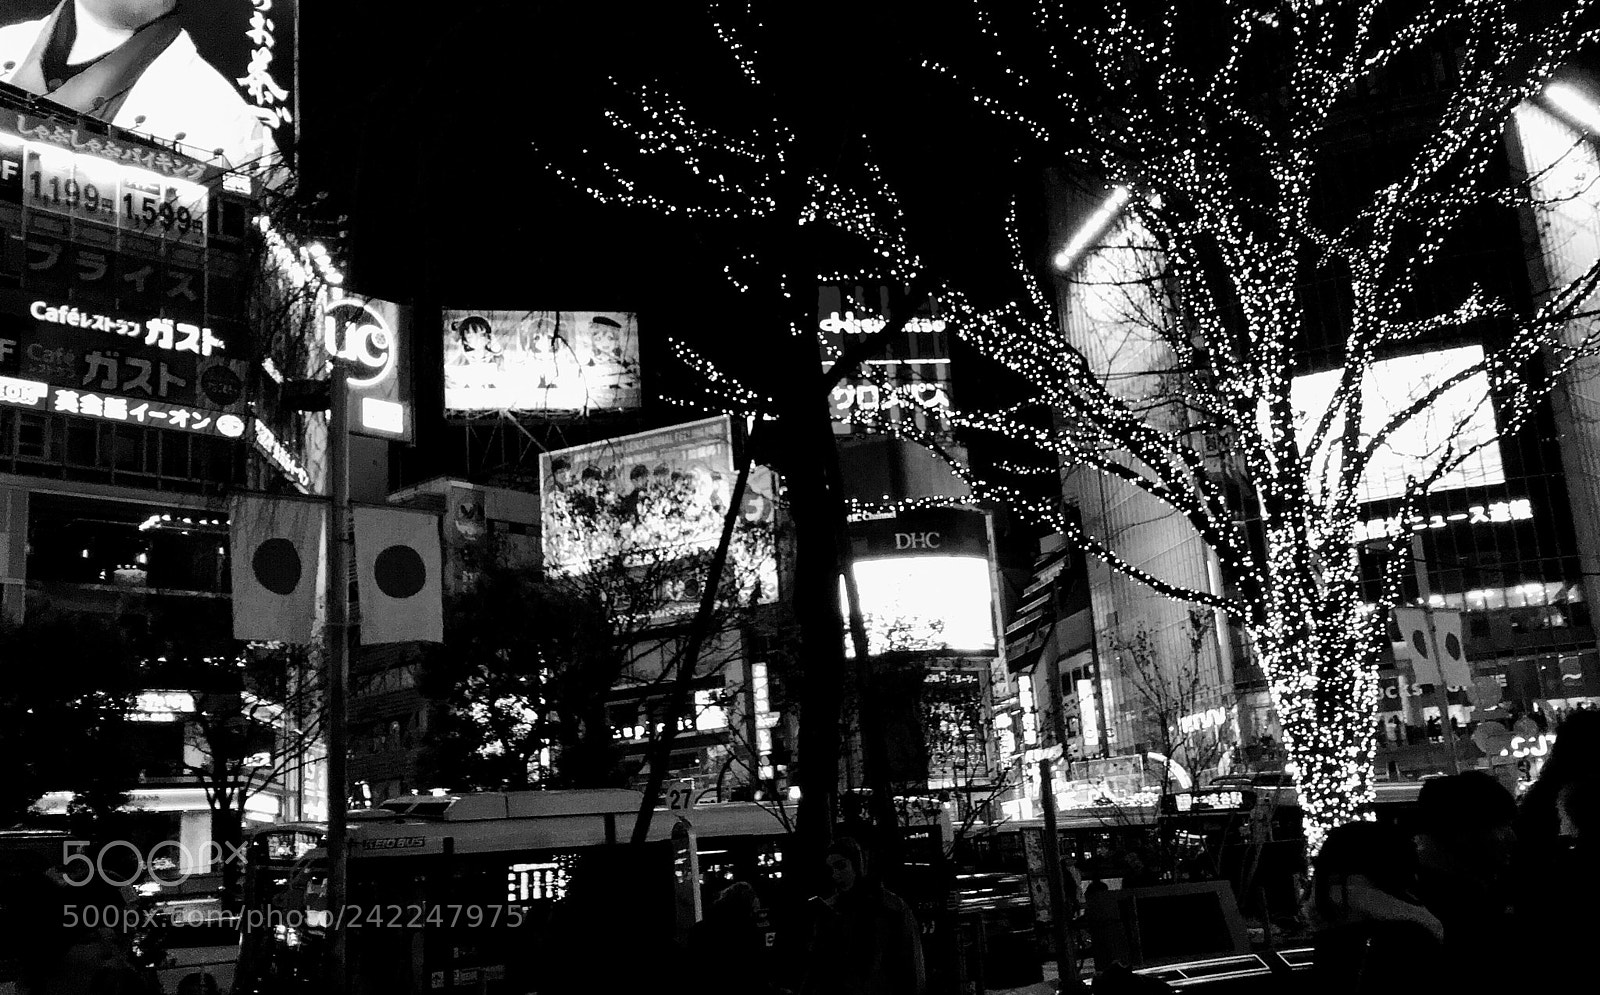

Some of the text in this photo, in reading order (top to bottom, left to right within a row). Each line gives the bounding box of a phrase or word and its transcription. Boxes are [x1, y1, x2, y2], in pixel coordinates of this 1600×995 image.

[144, 317, 226, 357] ガスト
[82, 350, 187, 398] ガスト
[895, 532, 941, 550] DHC
[670, 789, 692, 810] 27
[396, 836, 424, 849] BUS
